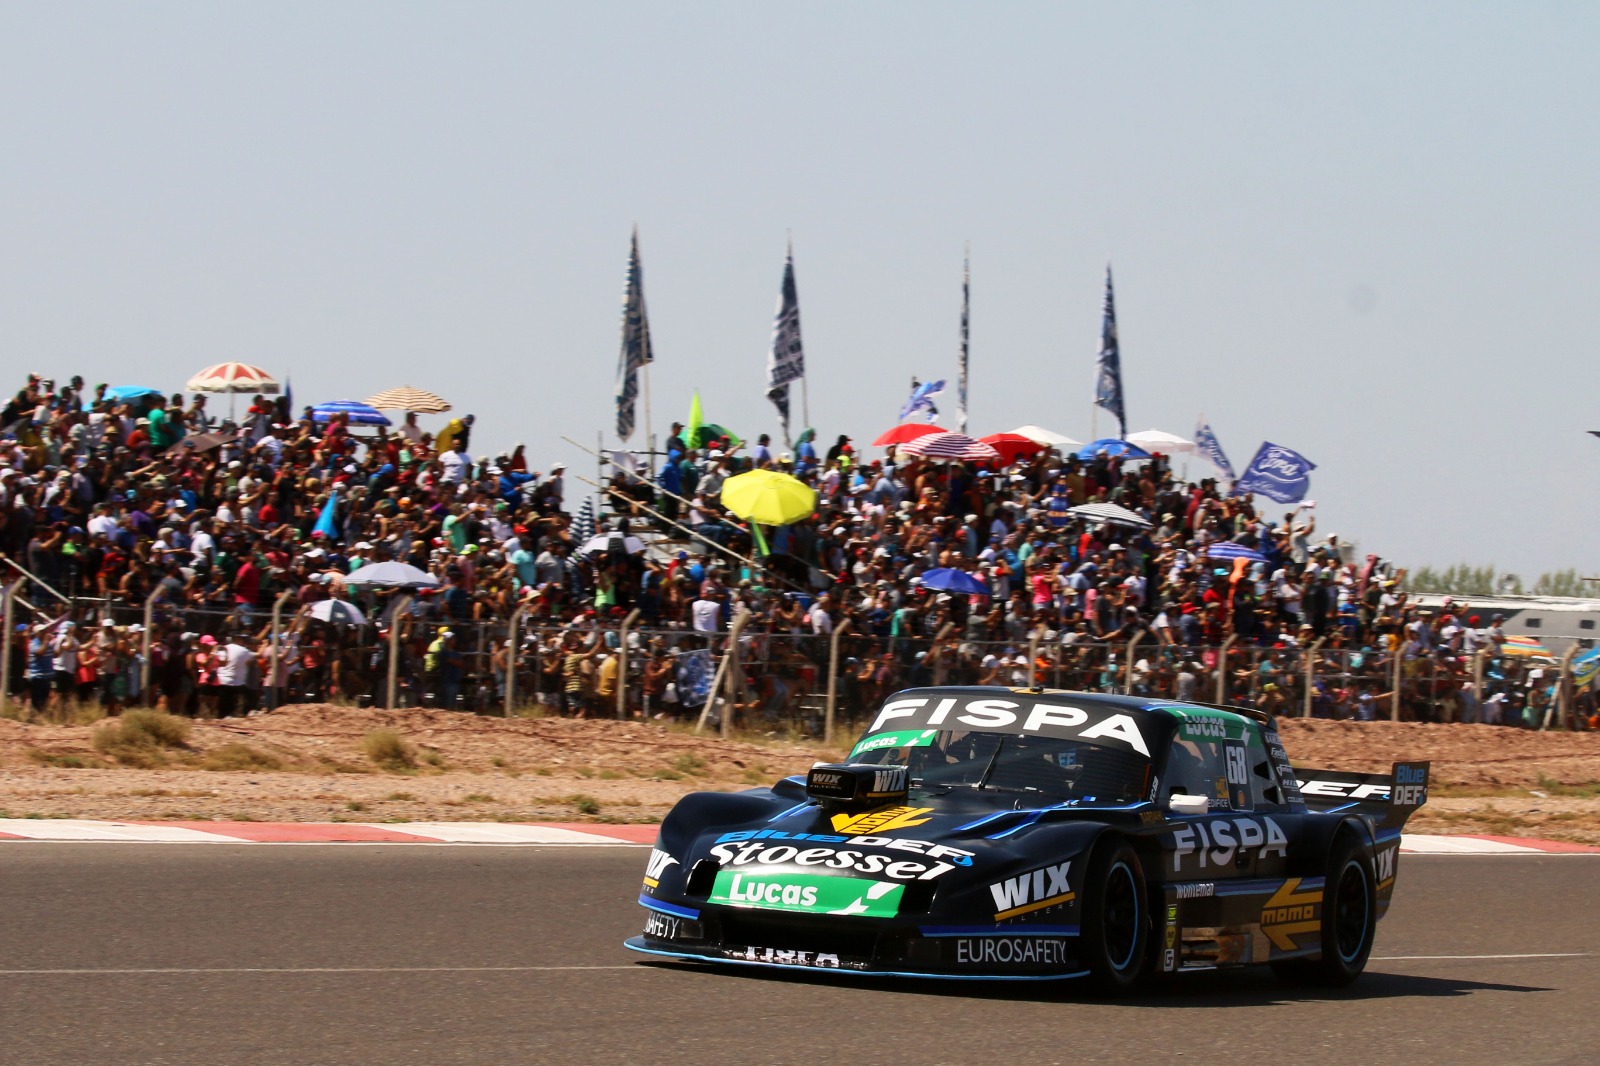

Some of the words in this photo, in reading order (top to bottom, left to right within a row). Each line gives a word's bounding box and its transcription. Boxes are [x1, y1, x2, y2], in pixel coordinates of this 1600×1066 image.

[868, 698, 1151, 758] FISPA
[1183, 715, 1227, 740] Lucas
[855, 735, 898, 754] Lucas
[812, 773, 842, 784] WIX
[872, 769, 907, 792] WIX
[1396, 764, 1425, 783] Blue
[1393, 784, 1423, 806] DEF
[1173, 816, 1289, 872] FISPA
[708, 840, 956, 881] Stoessel
[728, 873, 818, 906] Lucas
[989, 861, 1072, 912] WIX
[643, 911, 680, 940] SAFETY
[995, 900, 1075, 929] FILTERS
[1261, 906, 1314, 925] momo
[957, 938, 1067, 965] EUROSAFETY
